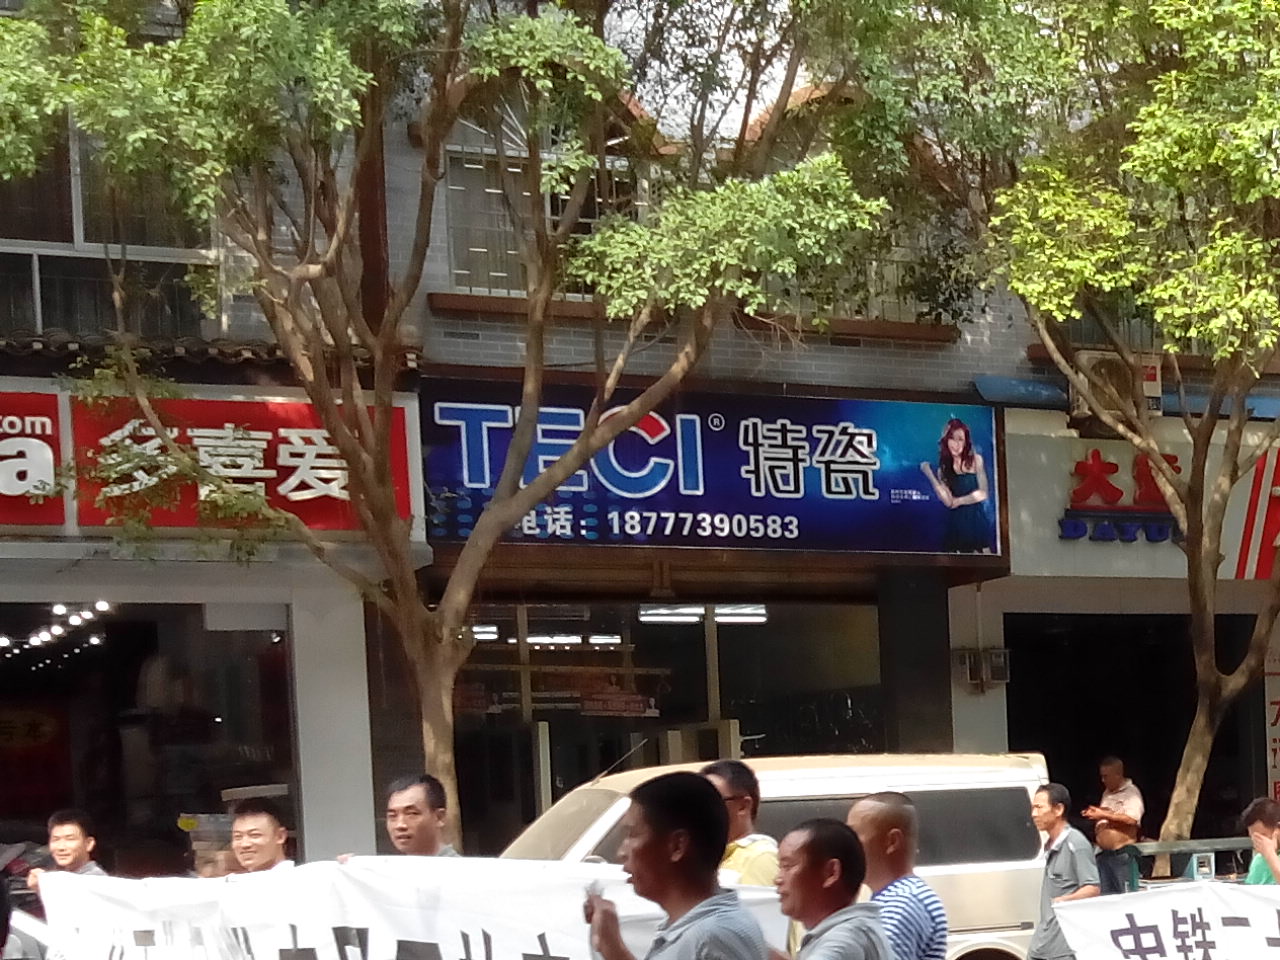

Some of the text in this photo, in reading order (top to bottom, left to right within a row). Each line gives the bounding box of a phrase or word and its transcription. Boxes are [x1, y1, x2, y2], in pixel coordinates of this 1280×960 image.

[0, 416, 52, 434] om
[739, 418, 879, 499] 特瓷
[607, 511, 799, 538] 18777390583
